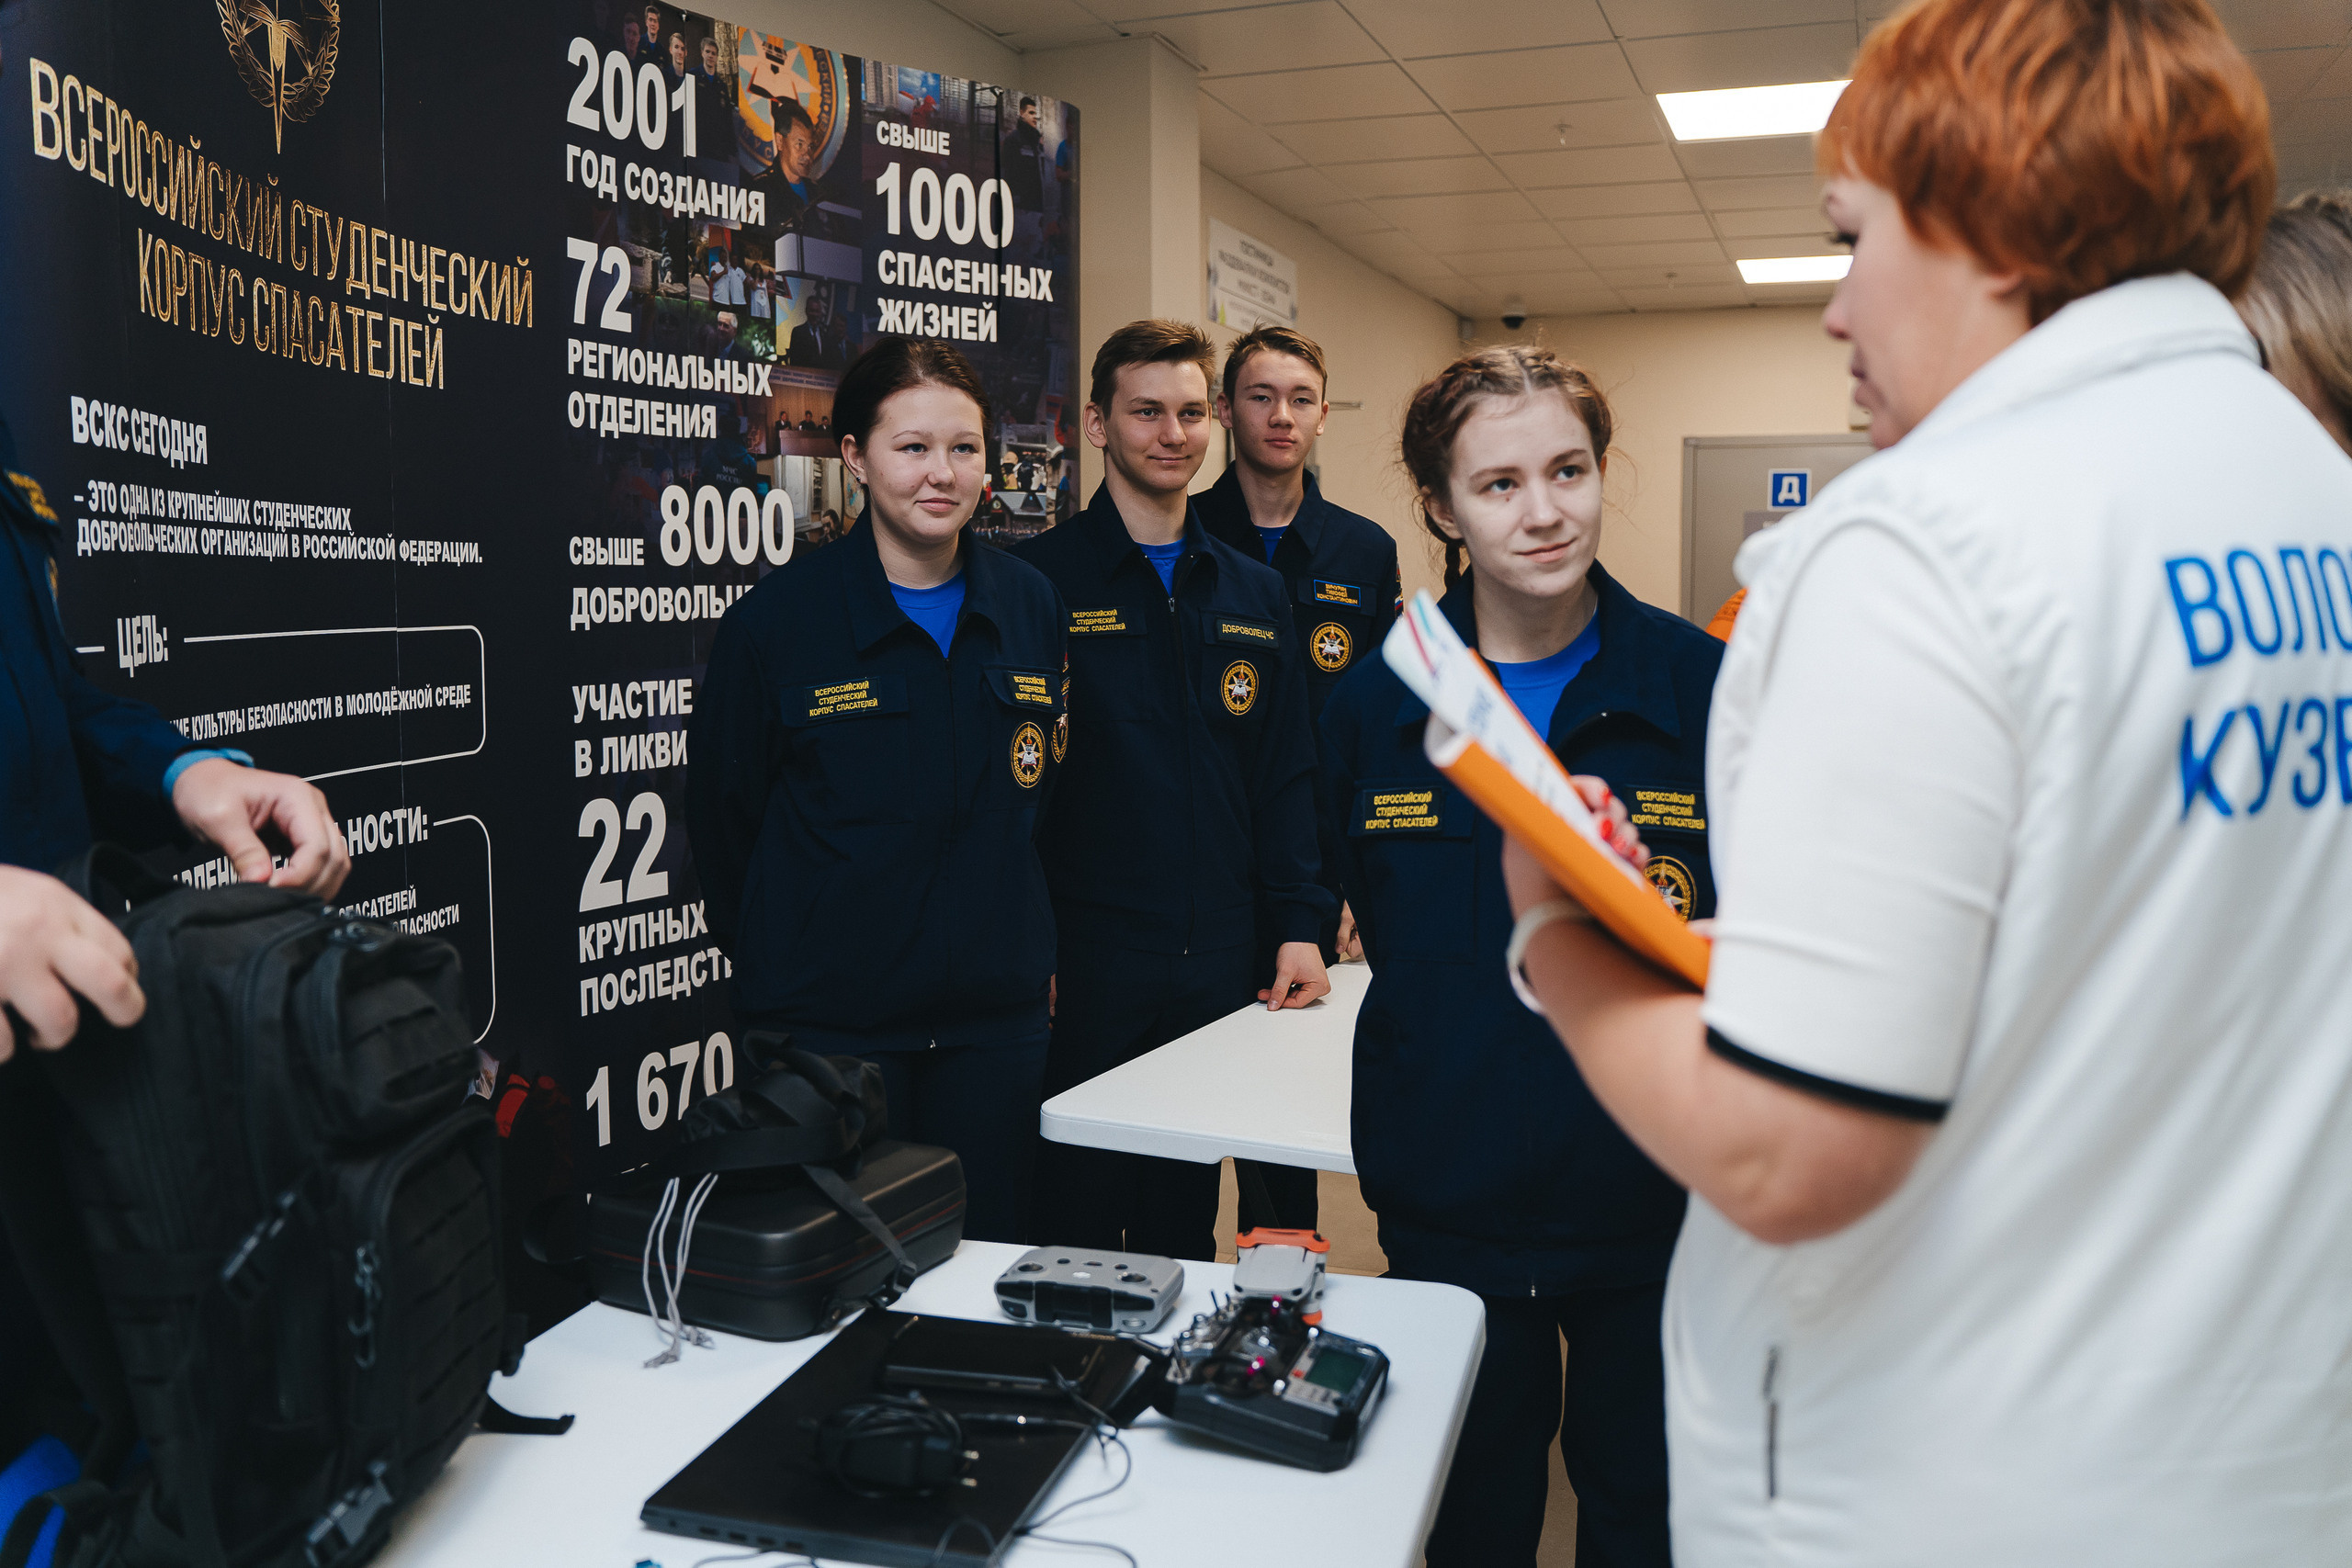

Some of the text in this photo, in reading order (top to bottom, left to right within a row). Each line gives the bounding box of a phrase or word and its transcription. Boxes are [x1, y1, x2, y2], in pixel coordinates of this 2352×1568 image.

[567, 37, 696, 158] 2001
[876, 119, 951, 156] СВЫШЕ
[29, 57, 533, 328] ВСЕРОССИЙСКИЙ СТУДЕНЧЕСКИЙ
[566, 143, 766, 226] ГОД СОЗДАНИЯ
[876, 162, 1014, 249] 1000
[567, 236, 632, 333] 72
[877, 249, 1054, 303] СПАСЕННЫХ
[137, 228, 445, 389] КОРПУС СПАСАТЕЛЕЙ
[877, 297, 998, 344] ЖИЗНЕЙ
[567, 338, 774, 397] РЕГИОНАЛЬНЫХ
[71, 395, 208, 469] ВСКС СЕГОДНЯ
[567, 392, 717, 439] ОТДЕЛЕНИЯ
[88, 479, 117, 513] ЭТО
[120, 484, 150, 521] ОДНА
[151, 488, 165, 517] ИЗ
[167, 490, 251, 525] КРУПНЕЙШИХ
[254, 500, 352, 532] СТУДЕНЧЕСКИХ
[1778, 476, 1801, 503] Д
[77, 518, 483, 567] ДОБРОВОЛЬЧЕСКИХ ОРГАНИЗАЦИЙ В РОССИЙСКОЙ ФЕДЕРАЦИИ.
[570, 484, 795, 567] СВЫШЕ 8000
[571, 585, 754, 631] ДОБРОВОЛЬ
[1072, 608, 1118, 618] ВСЕРОССИЙСКИЙ
[1076, 616, 1116, 626] СТУДЕНЧЕСКИЙ
[1091, 622, 1126, 632] СПАСАТЕЛЕЙ
[2165, 548, 2352, 668] ВОЛО
[117, 615, 168, 678] ЦЕЛЬ:
[191, 709, 246, 741] КУЛЬТУРЫ
[247, 696, 332, 731] БЕЗОПАСНОСТИ
[334, 695, 344, 717] В
[346, 683, 433, 716] МОЛОДЁЖНОЙ
[435, 684, 471, 708] СРЕДЕ
[571, 679, 693, 724] УЧАСТИЕ
[809, 698, 878, 716] КОРПУС СПАСАТЕЛЕЙ
[815, 681, 869, 697] ВСЕРОССИЙСКИЙ
[819, 690, 867, 705] СТУДЕНЧЕСКИЙ
[574, 729, 688, 778] В ЛИКВИ
[1365, 815, 1439, 829] КОРПУС СПАСАТЕЛЕЙ
[1374, 791, 1432, 806] ВСЕРОССИЙСКИЙ
[1375, 803, 1428, 818] СТУДЕНЧЕСКИЙ
[1636, 791, 1696, 806] ВСЕРОССИЙСКИЙ
[578, 791, 669, 912] 22
[579, 899, 708, 963] КРУПНЫХ
[586, 1032, 733, 1147] 1 670
